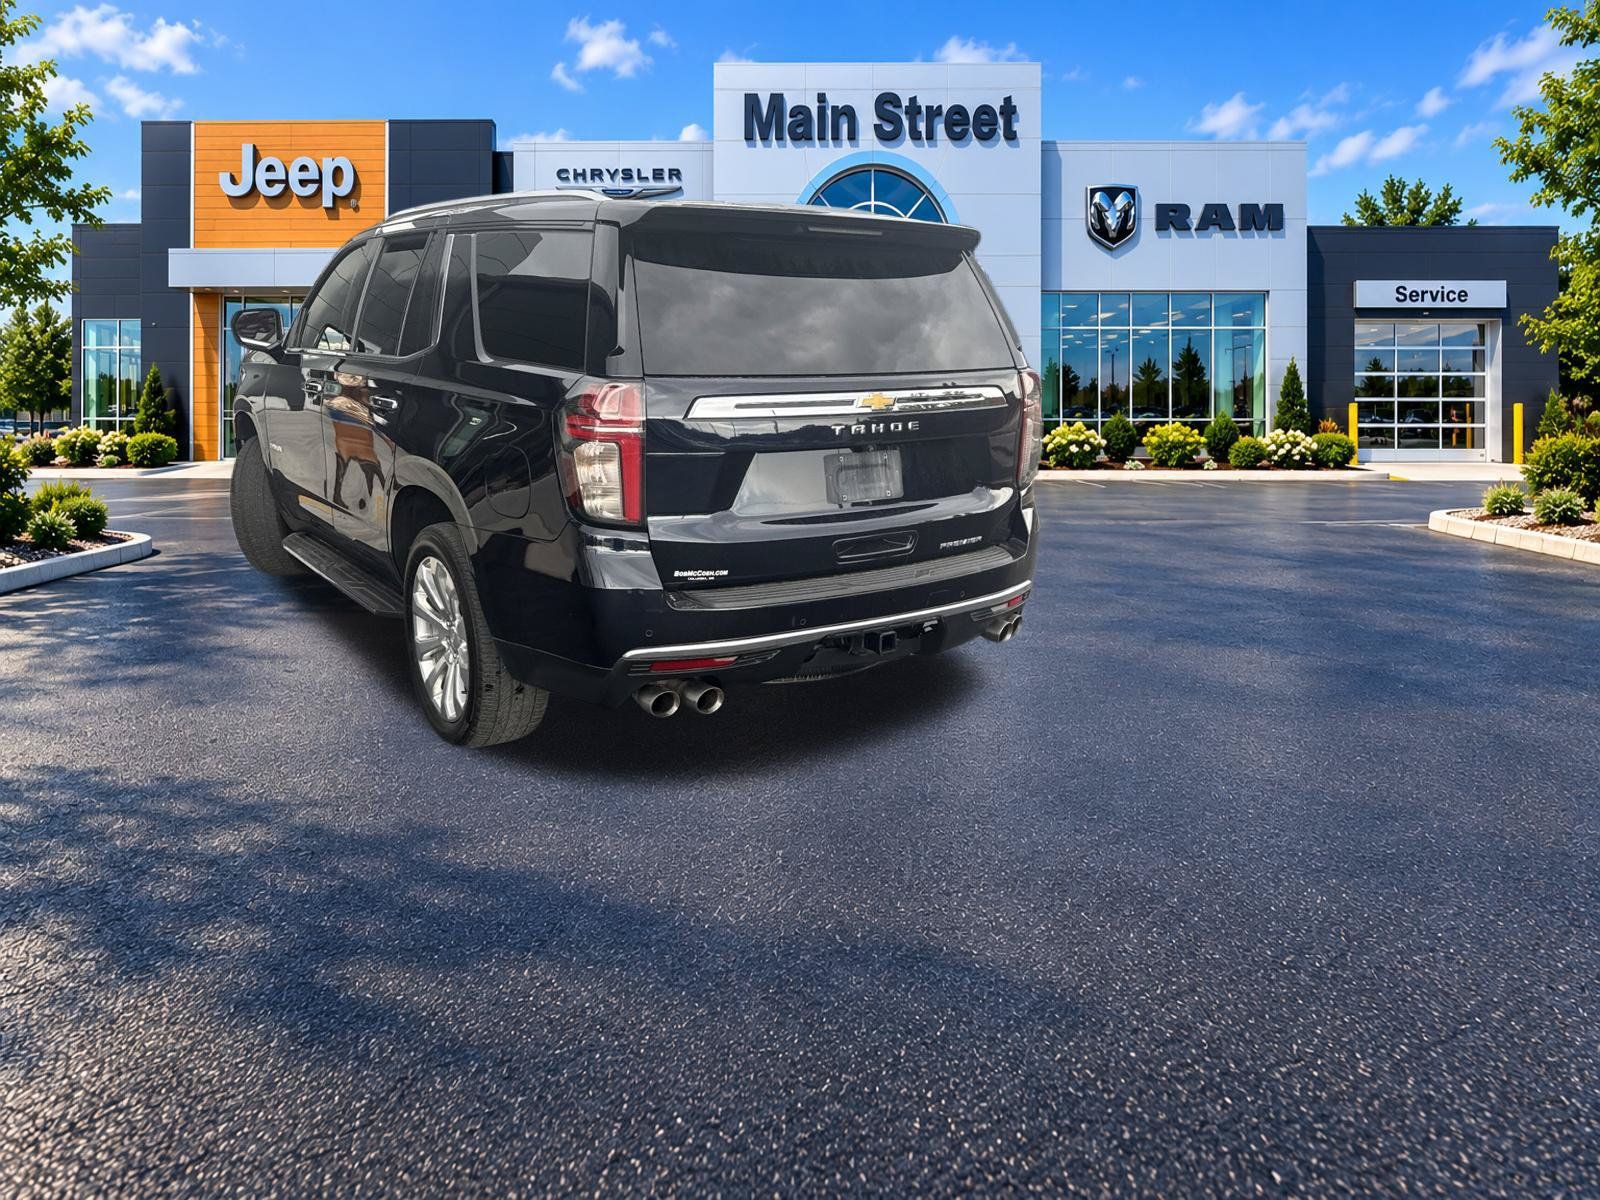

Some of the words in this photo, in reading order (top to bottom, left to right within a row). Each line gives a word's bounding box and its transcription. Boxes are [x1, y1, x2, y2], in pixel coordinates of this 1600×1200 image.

[744, 93, 857, 142] Main
[873, 92, 1018, 142] Street
[219, 143, 355, 208] Jeep
[556, 168, 683, 183] CHRYSLER
[1155, 203, 1284, 231] RAM
[1395, 285, 1469, 304] Service
[831, 421, 919, 435] TAHOE
